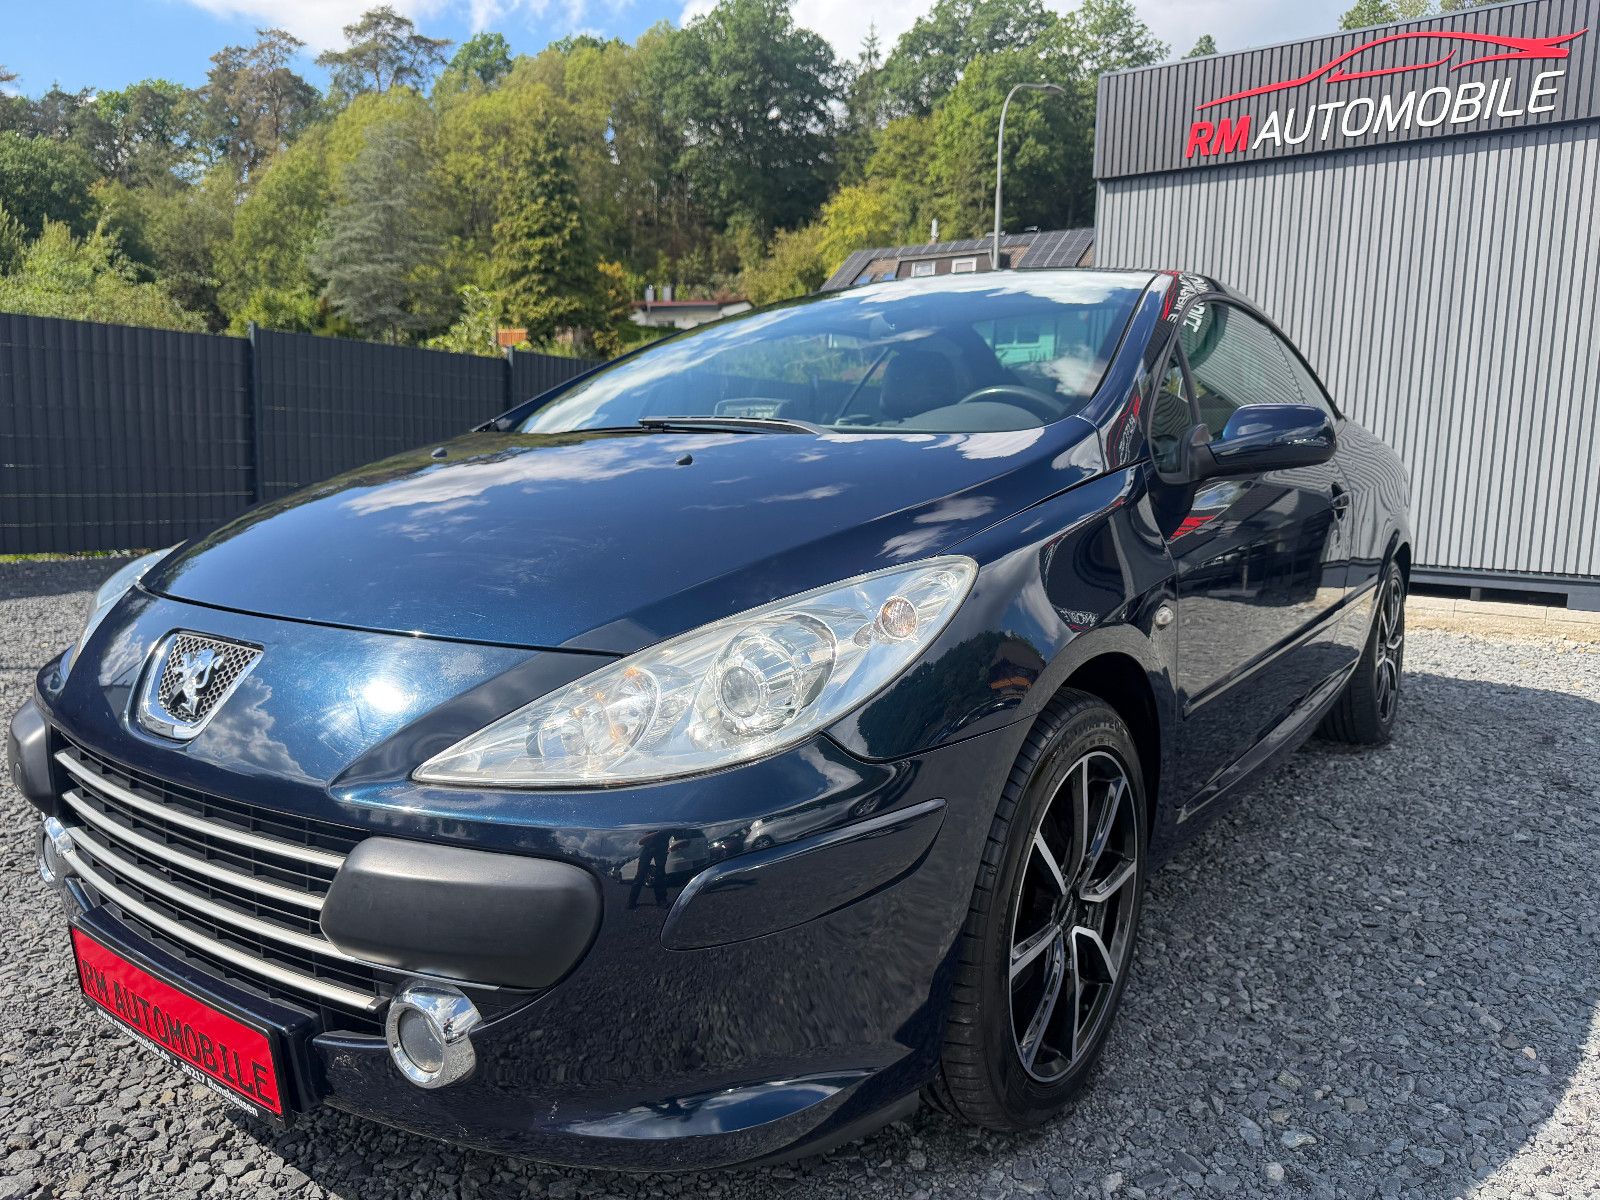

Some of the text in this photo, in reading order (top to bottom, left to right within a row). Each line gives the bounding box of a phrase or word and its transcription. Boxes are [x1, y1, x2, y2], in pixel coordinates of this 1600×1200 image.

[1185, 70, 1566, 158] RM AUTOMOBILE
[82, 960, 275, 1107] RM AUTOMOBILE
[180, 1061, 206, 1084] 36217
